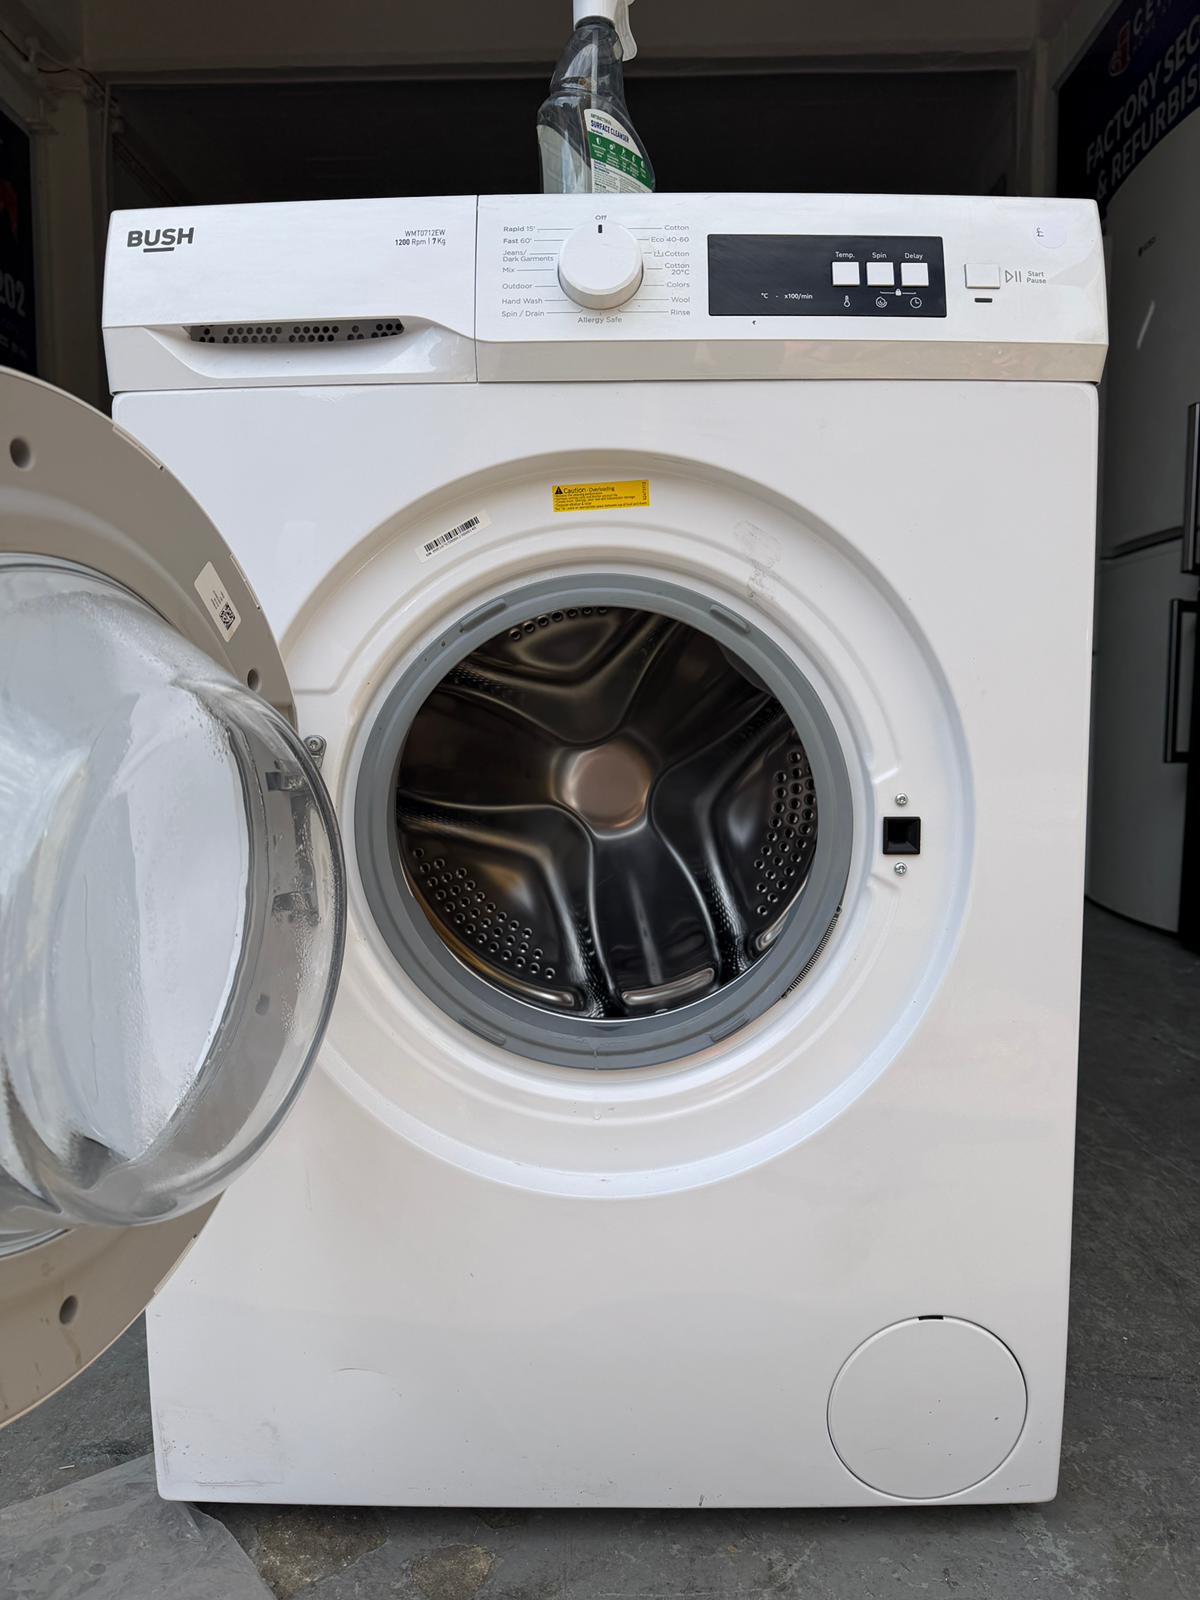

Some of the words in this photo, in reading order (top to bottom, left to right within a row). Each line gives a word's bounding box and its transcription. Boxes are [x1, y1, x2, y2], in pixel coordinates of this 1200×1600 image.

[1086, 60, 1162, 175] FACTORY
[1110, 60, 1200, 187] REFURBIS
[126, 227, 195, 249] BUSH
[395, 238, 410, 246] 1200
[411, 238, 427, 246] Rpm
[432, 237, 437, 245] 7
[437, 237, 446, 246] Kg
[835, 251, 855, 259] Temp.
[904, 252, 923, 260] Delay
[784, 292, 813, 300] x100/min
[501, 310, 518, 318] Spin
[577, 316, 604, 324] Allergy
